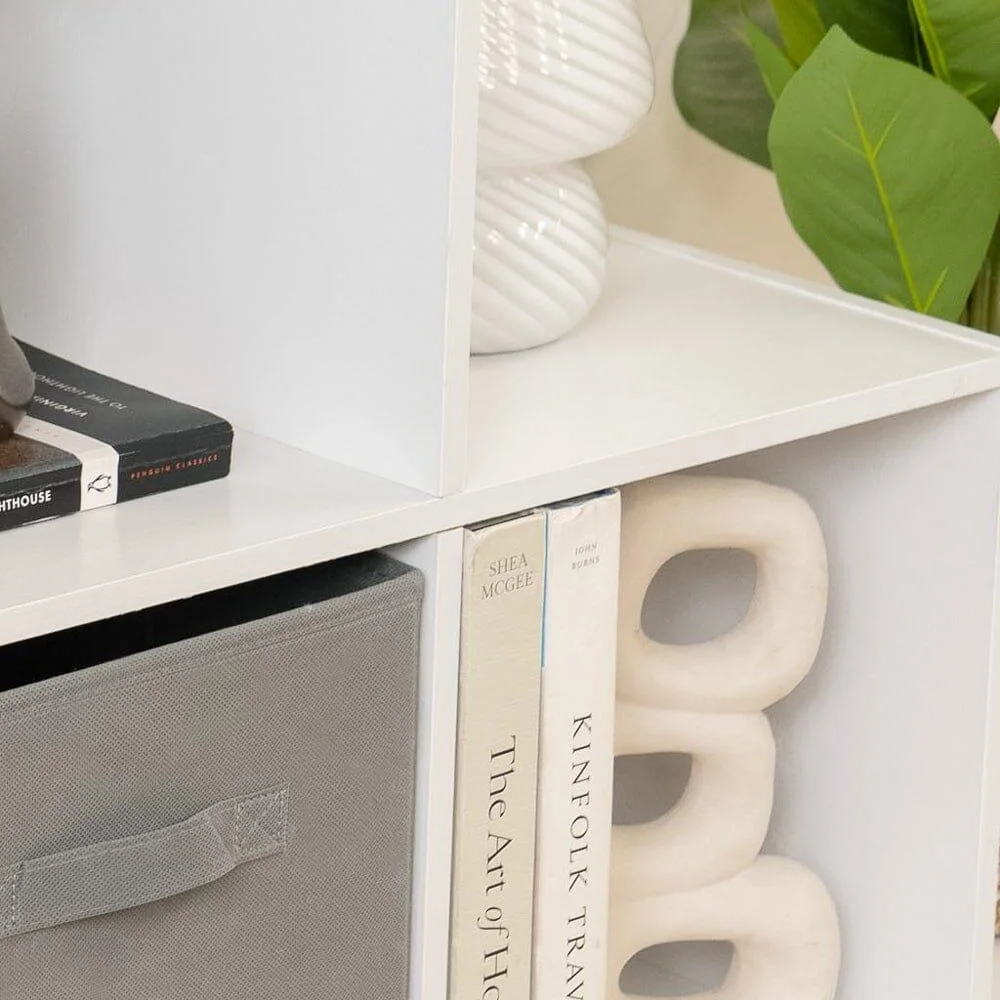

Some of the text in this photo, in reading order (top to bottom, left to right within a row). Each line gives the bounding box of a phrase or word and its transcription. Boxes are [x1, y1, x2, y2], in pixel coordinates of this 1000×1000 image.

[130, 454, 219, 480] PENGUIN CLASSICS
[488, 553, 528, 577] SHEA
[480, 571, 534, 600] MCGEE
[487, 734, 517, 821] The
[568, 713, 593, 893] KINFOLK
[485, 832, 515, 896] Art
[476, 906, 510, 940] of
